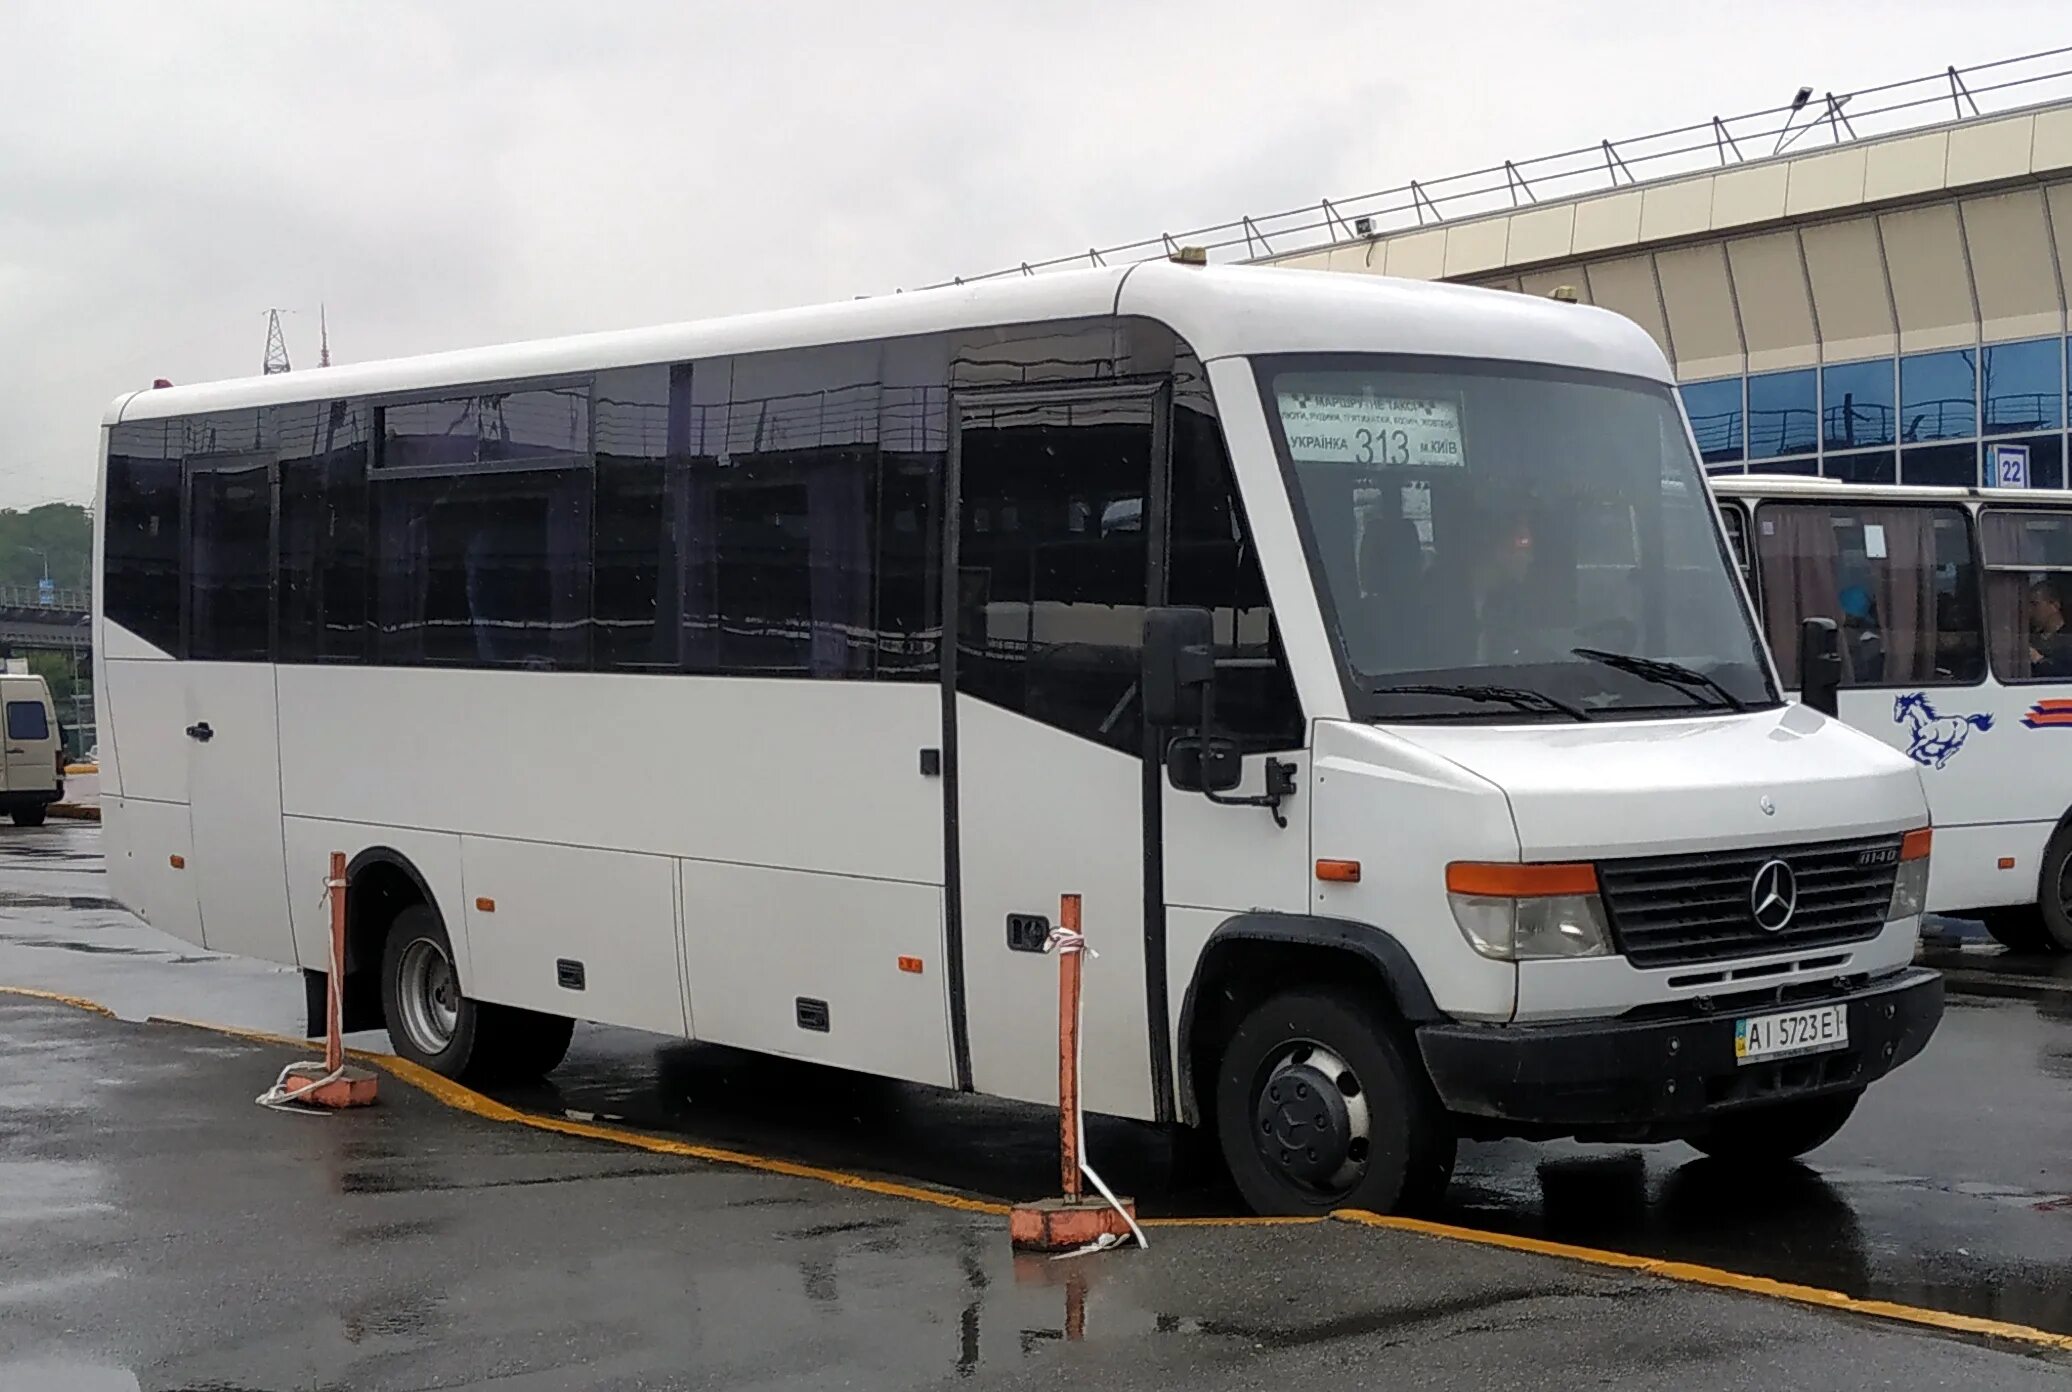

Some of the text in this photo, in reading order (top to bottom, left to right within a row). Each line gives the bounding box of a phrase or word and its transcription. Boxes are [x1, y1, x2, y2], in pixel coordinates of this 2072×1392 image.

[1315, 396, 1385, 410] МАРШРУНЕ
[1290, 433, 1348, 450] УКРАЇНКА
[1356, 428, 1409, 464] 313
[2003, 460, 2021, 482] 22
[1749, 1021, 1771, 1051] AI
[1780, 1015, 1818, 1045] 5723
